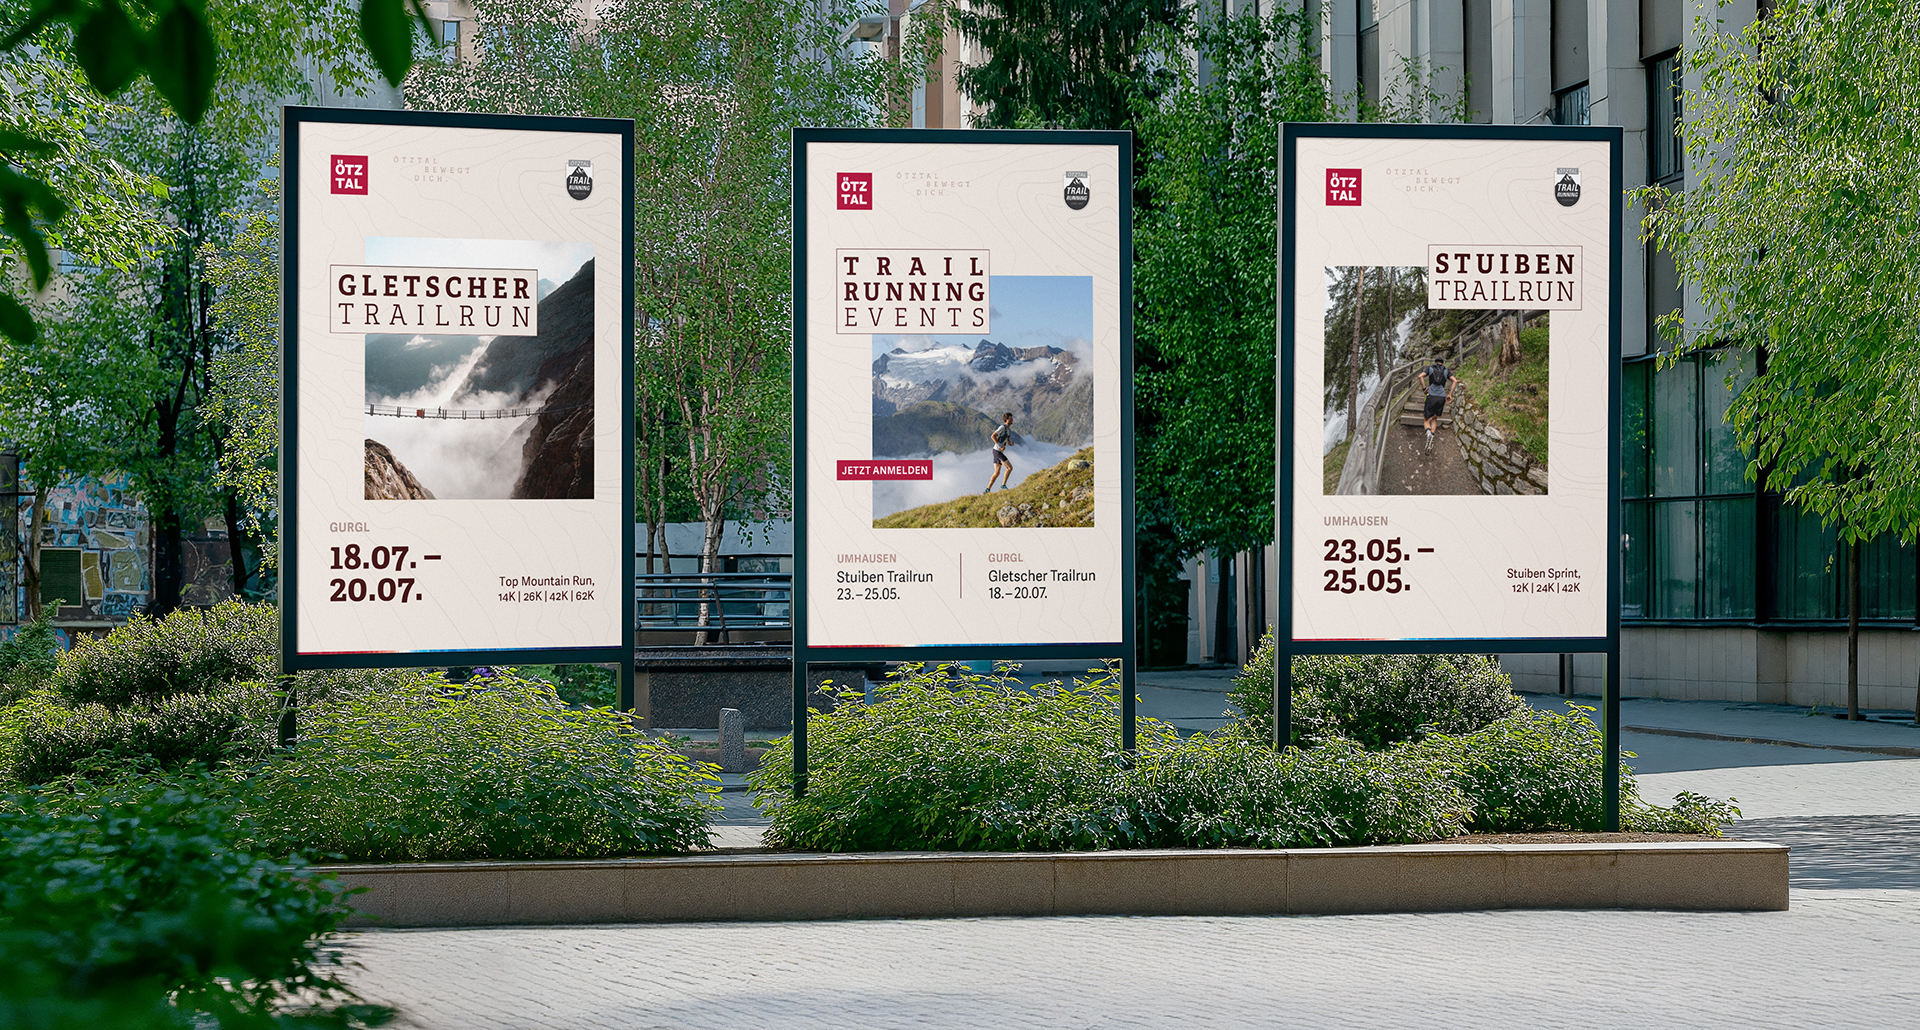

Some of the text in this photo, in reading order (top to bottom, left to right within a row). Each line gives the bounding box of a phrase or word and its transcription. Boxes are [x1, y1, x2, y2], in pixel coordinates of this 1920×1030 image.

[393, 156, 438, 164] ÖTZTAL
[335, 160, 363, 176] ÖTZ
[424, 166, 471, 174] BEWEGT
[336, 178, 362, 189] TAL
[570, 176, 590, 184] TRAIL
[841, 177, 867, 192] ÖTZ
[1330, 173, 1356, 188] ÖTZ
[842, 194, 867, 204] TAL
[1330, 190, 1356, 200] TAL
[844, 257, 983, 276] TRAIL
[1436, 252, 1574, 274] STUIBEN
[338, 274, 530, 299] GLETSCHER
[844, 282, 984, 302] RUNNING
[1436, 280, 1574, 302] TRAILRUN
[338, 303, 530, 327] TRAILRUN
[845, 308, 984, 327] EVENTS
[842, 466, 928, 475] JETZT ANMELDEN
[330, 522, 370, 532] GURGL
[1324, 516, 1388, 526] UMHAUSEN
[837, 554, 896, 563] UMHAUSEN
[988, 553, 1023, 562] GURGL
[837, 570, 934, 583] Stuiben Trailrun
[988, 569, 1096, 582] Gletscher Trailrun
[1507, 568, 1581, 580] Stuiben Sprint,
[500, 576, 595, 588] Top Mountain Run,
[1324, 567, 1410, 594] 25.05.
[330, 578, 423, 603] 20.07.
[1512, 583, 1529, 592] 12K
[1536, 583, 1555, 592] 24K
[1562, 583, 1580, 592] 42K
[498, 592, 516, 602] 14K
[523, 591, 542, 601] 26K
[549, 590, 568, 601] 42K
[576, 590, 594, 600] 62K
